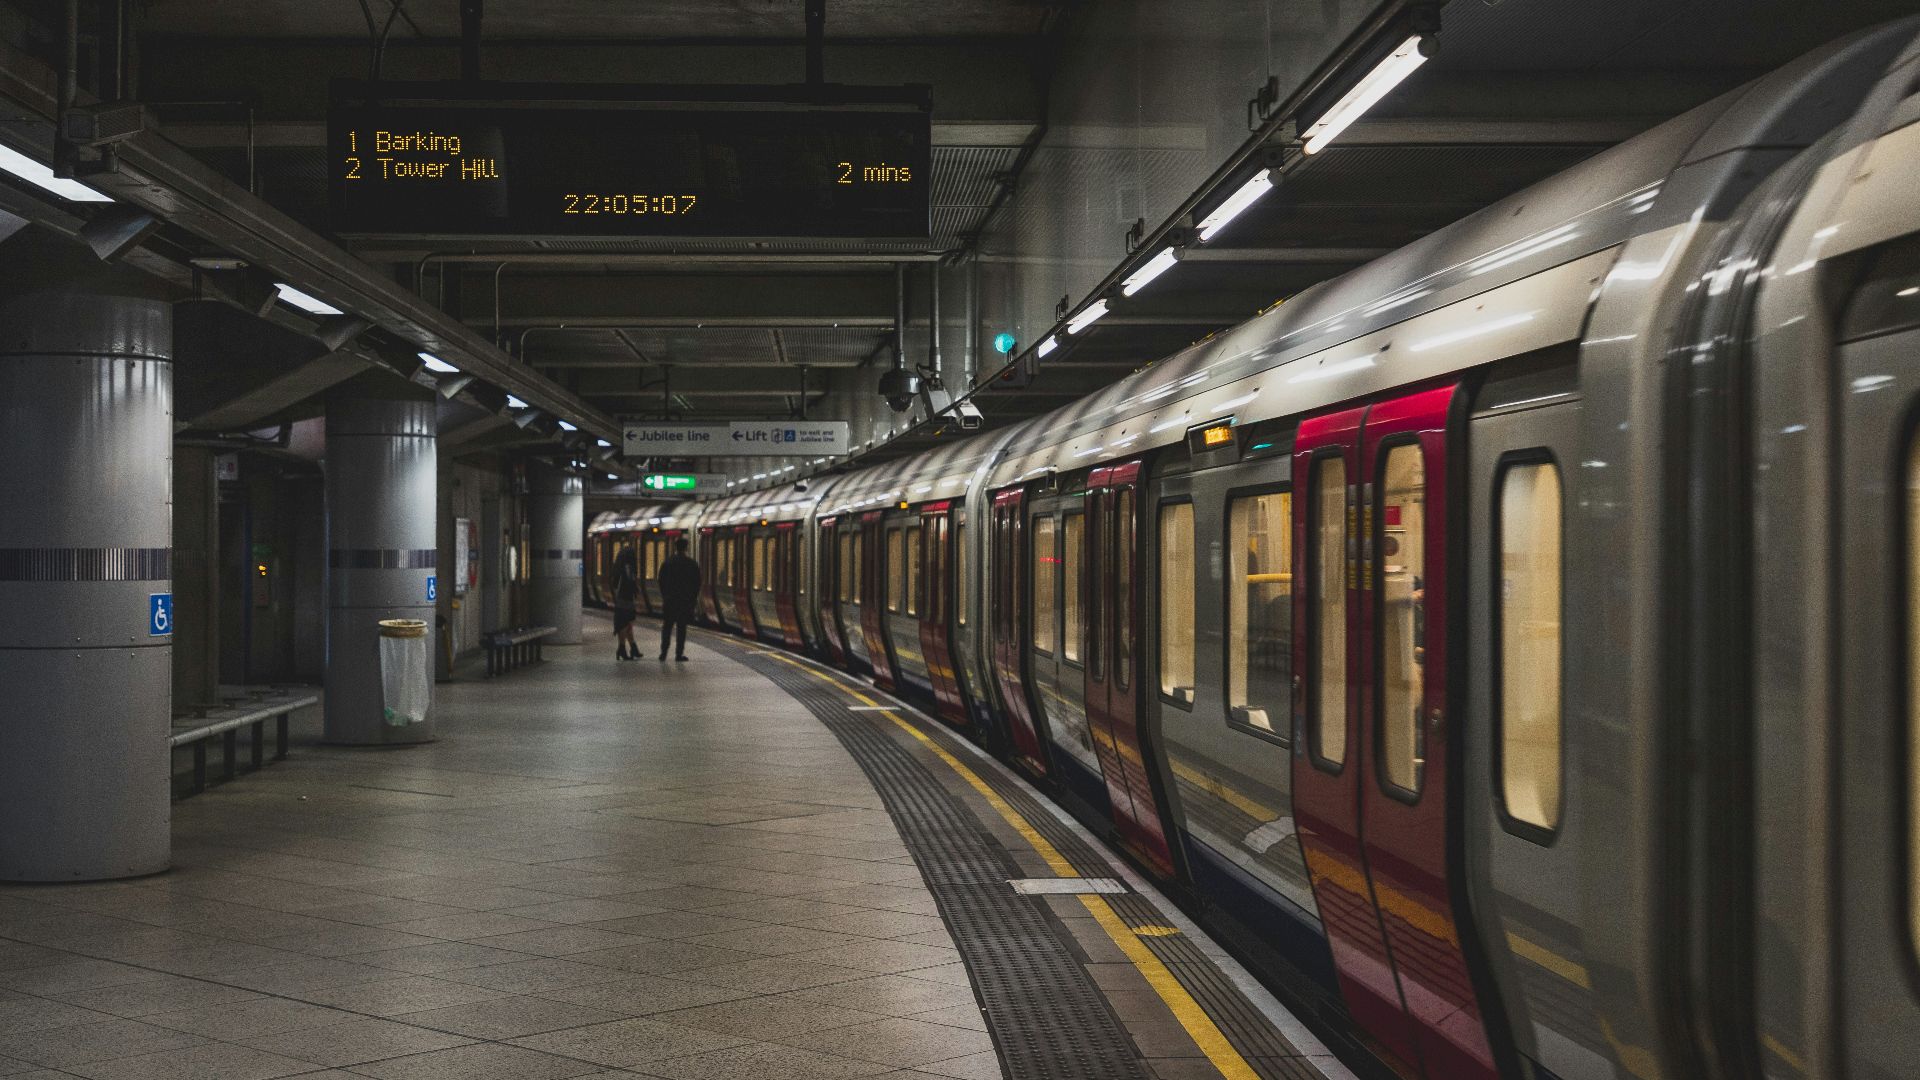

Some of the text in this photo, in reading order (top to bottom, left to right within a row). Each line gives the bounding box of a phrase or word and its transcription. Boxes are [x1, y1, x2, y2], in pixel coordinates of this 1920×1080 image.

[349, 131, 461, 155] 1 Barking
[345, 157, 500, 179] 2 Tower Hill
[837, 162, 912, 184] 2 mins
[564, 194, 696, 215] 22:05:07
[640, 430, 710, 442] Jubilee line
[745, 430, 768, 441] Lift
